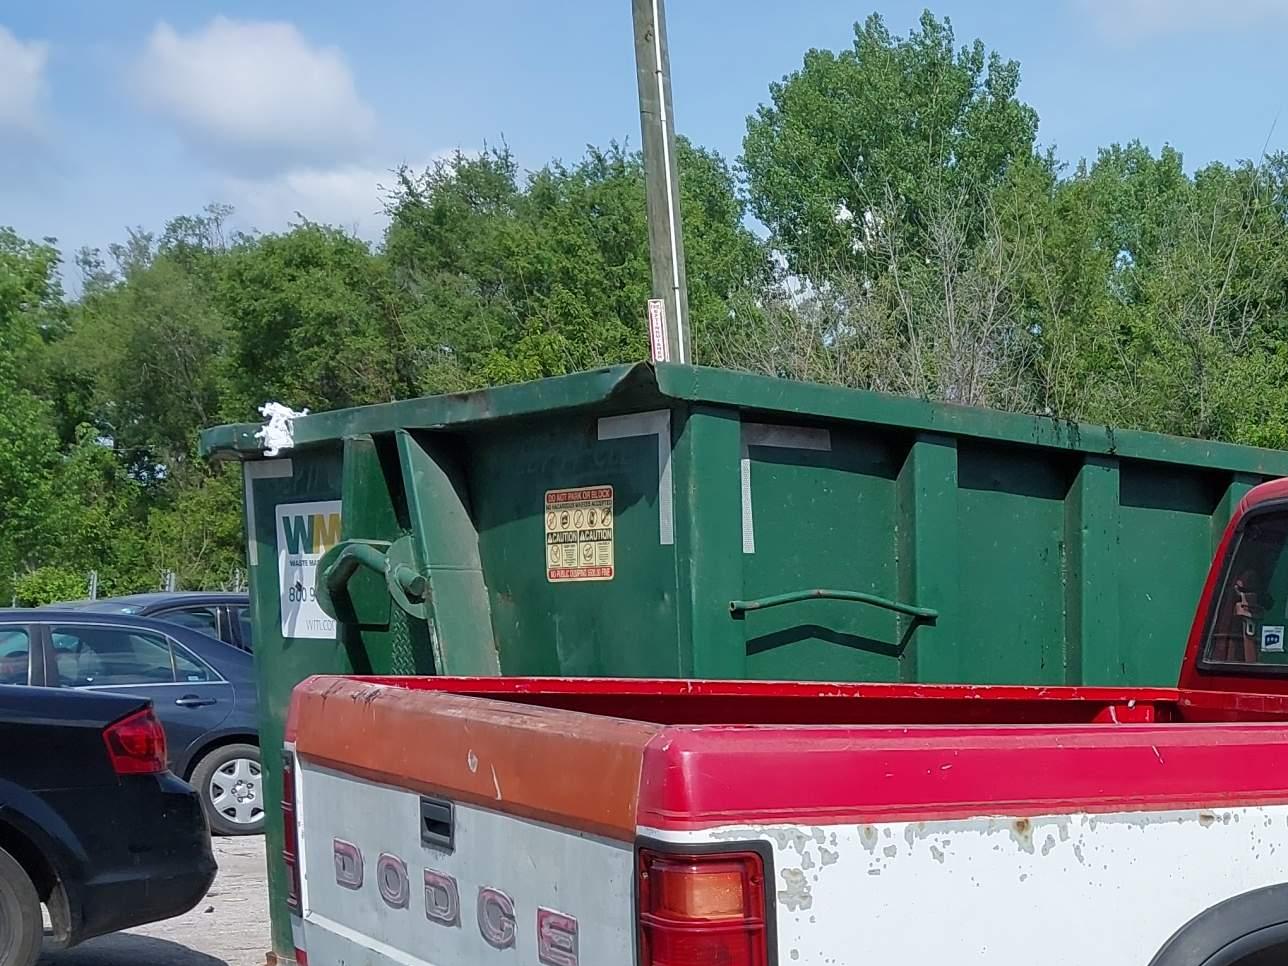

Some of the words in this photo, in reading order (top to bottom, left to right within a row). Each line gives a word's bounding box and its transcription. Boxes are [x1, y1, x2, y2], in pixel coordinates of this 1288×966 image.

[556, 493, 568, 502] NOT
[567, 492, 582, 501] PARK
[582, 491, 591, 500] OR
[591, 489, 610, 499] BLOCK
[282, 512, 341, 554] WM
[552, 531, 577, 543] CAUTION
[585, 529, 612, 540] CAUTION
